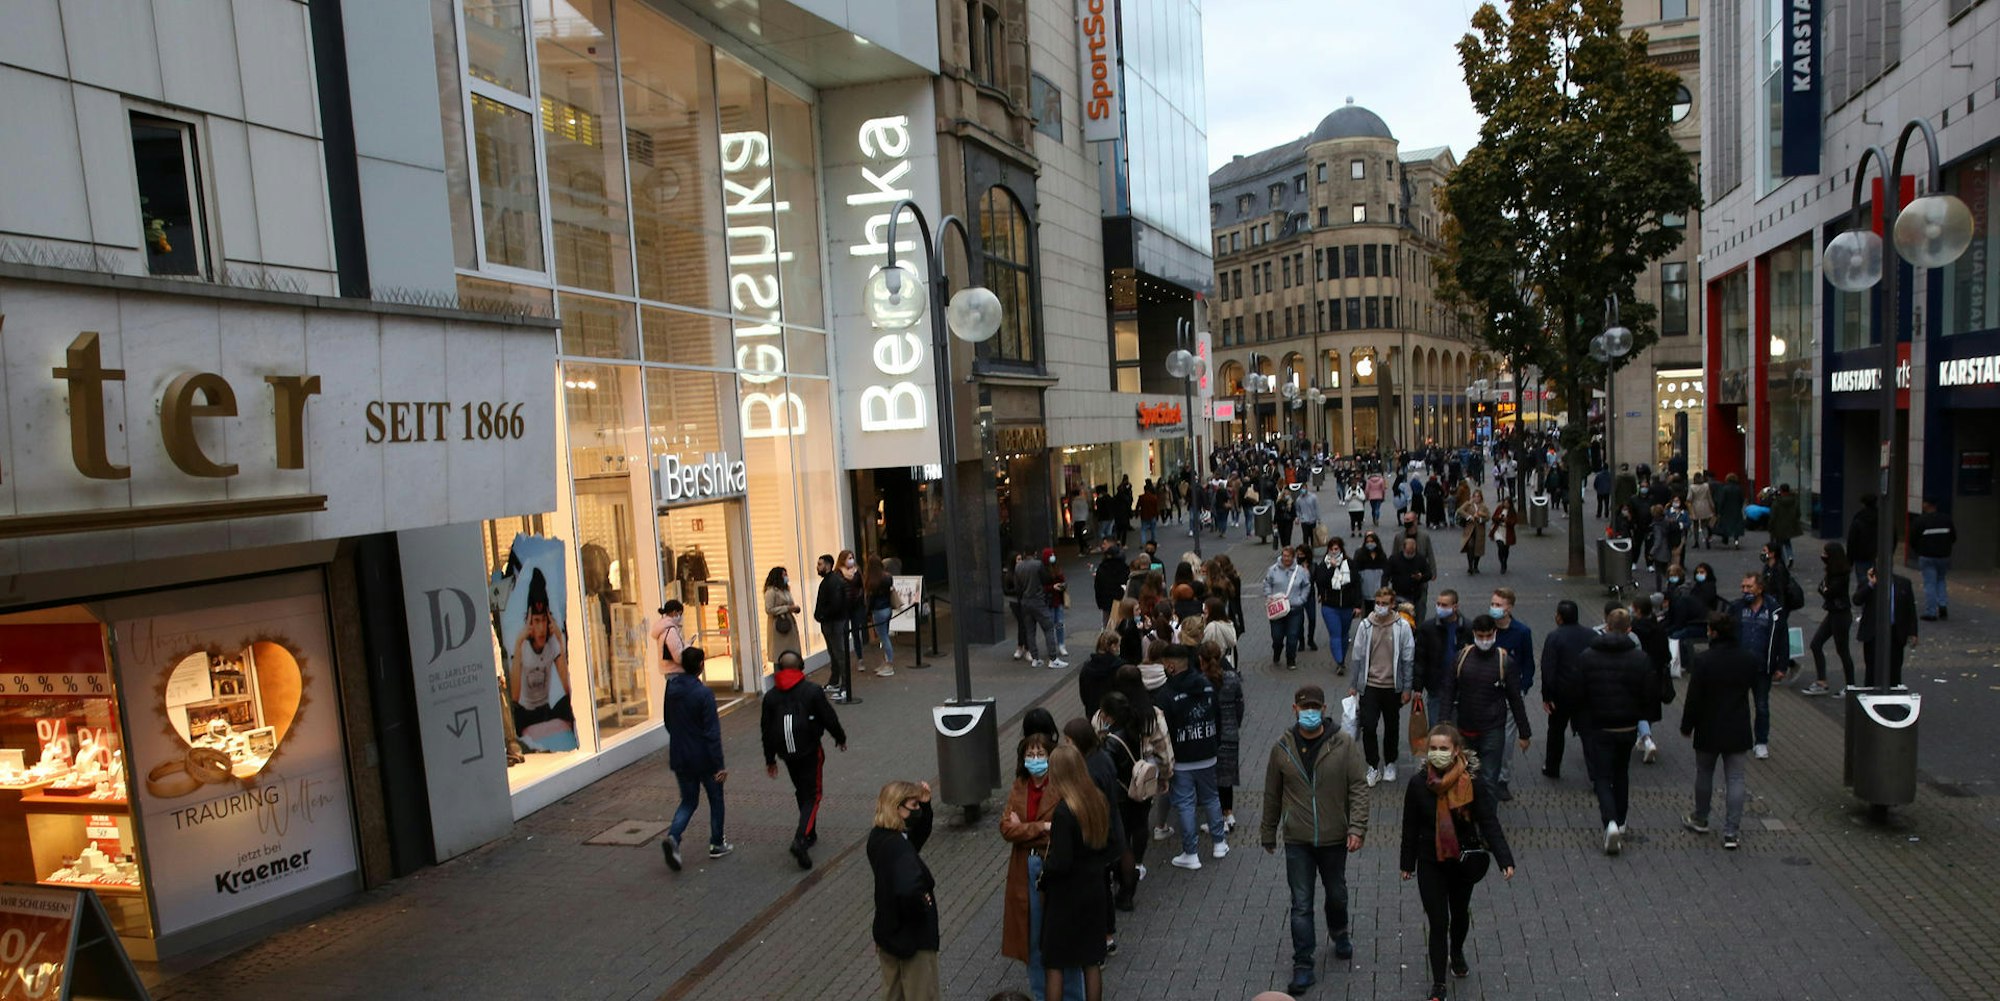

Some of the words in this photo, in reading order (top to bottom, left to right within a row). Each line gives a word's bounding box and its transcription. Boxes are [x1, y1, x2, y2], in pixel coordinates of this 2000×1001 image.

[0, 313, 321, 484] ter
[1831, 369, 1877, 393] KARSTADT
[366, 401, 451, 444] SEIT
[461, 401, 525, 441] 1866
[665, 451, 747, 500] Bershka
[171, 785, 280, 830] TRAURING
[215, 848, 312, 894] Kraemer
[264, 841, 282, 856] bei
